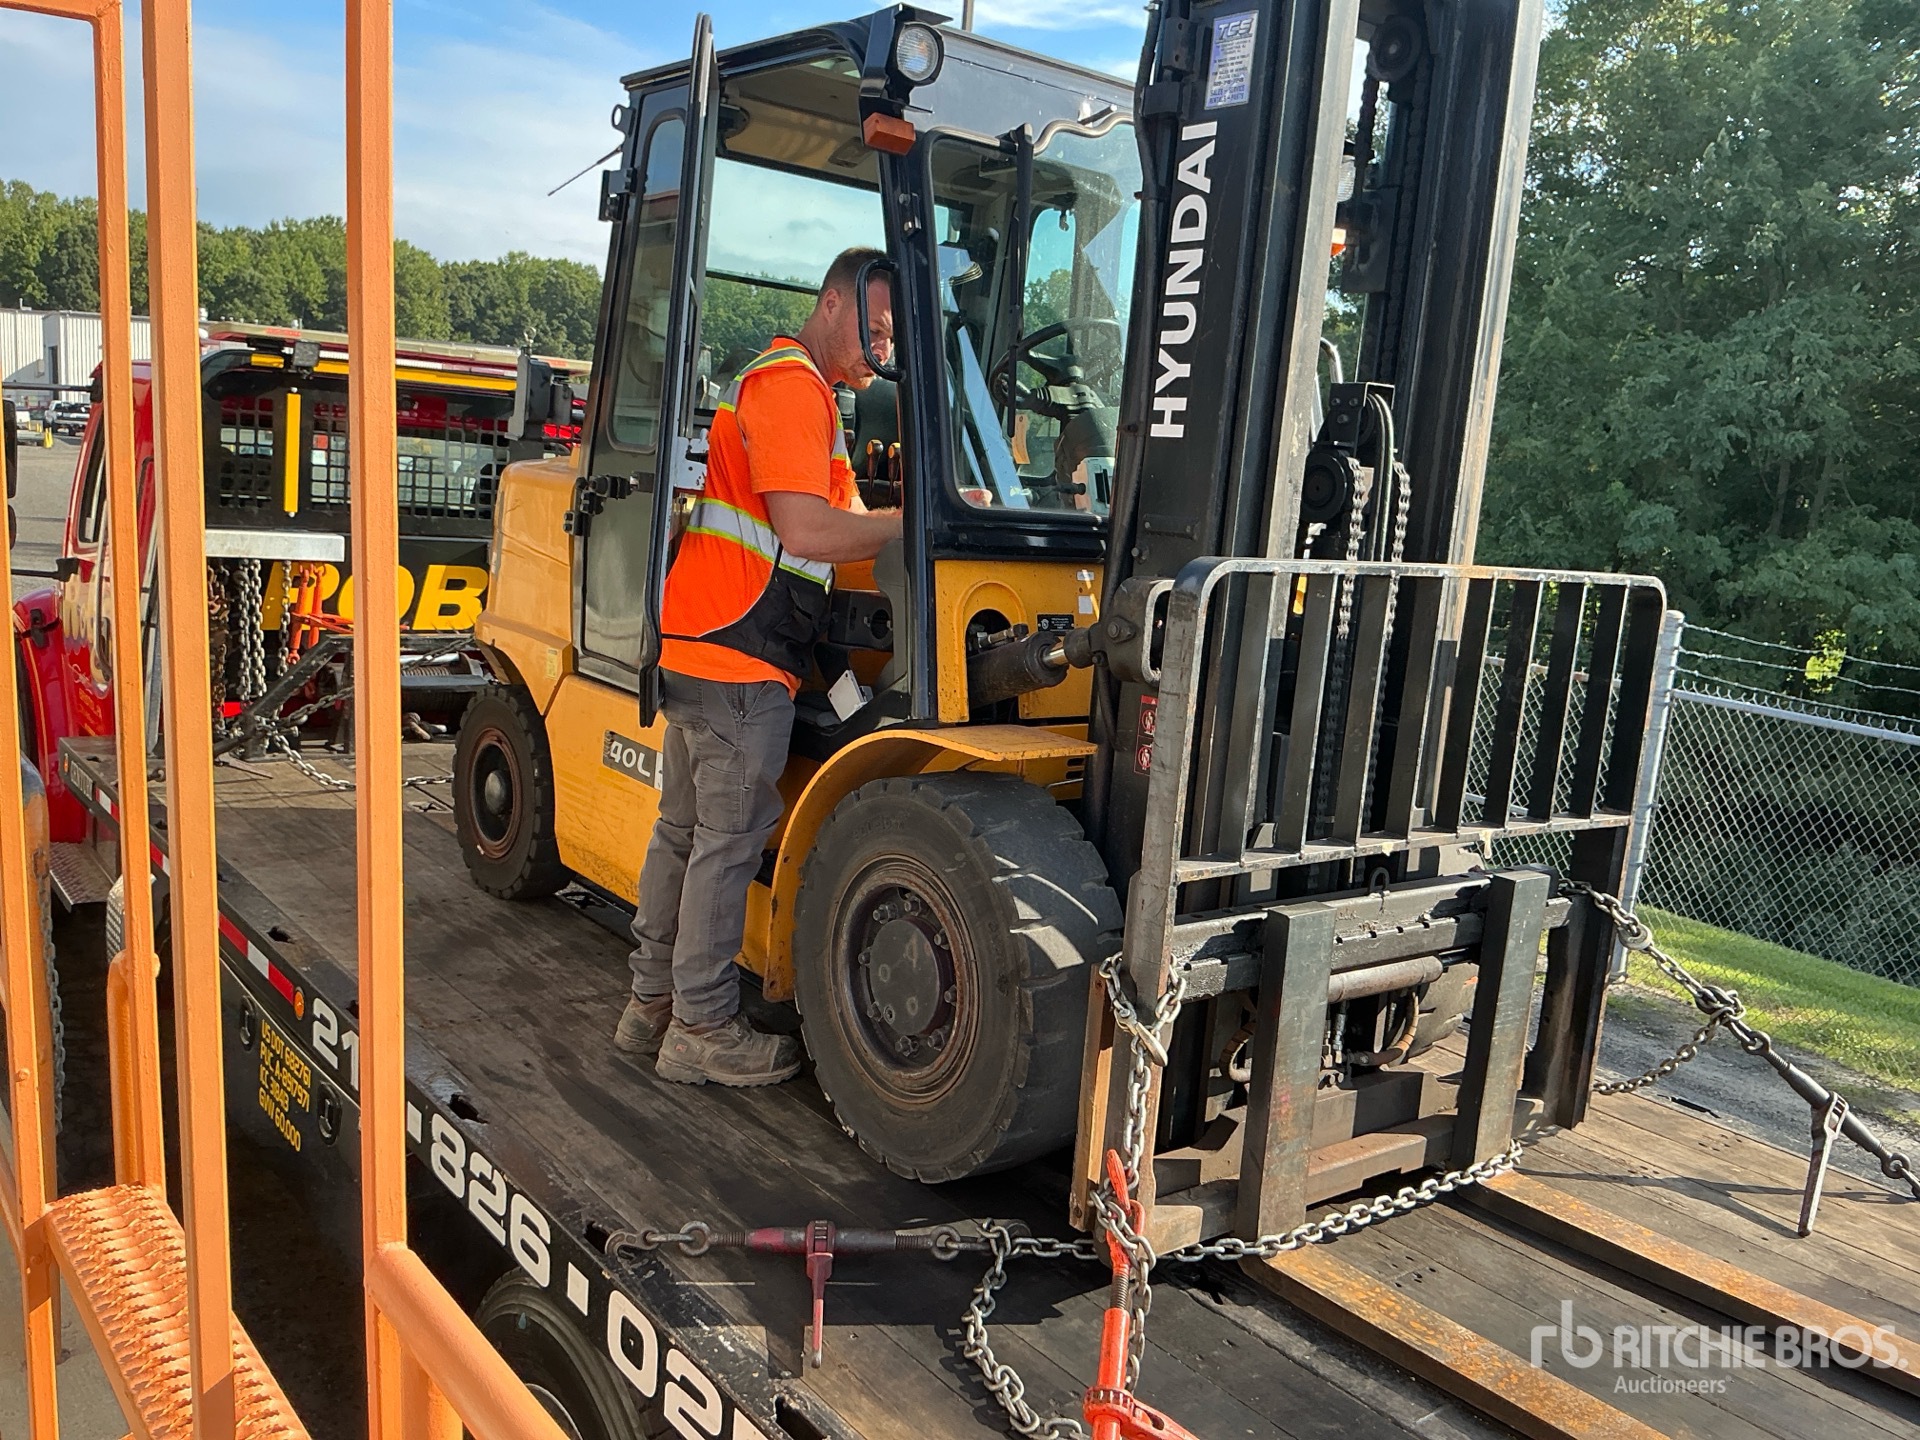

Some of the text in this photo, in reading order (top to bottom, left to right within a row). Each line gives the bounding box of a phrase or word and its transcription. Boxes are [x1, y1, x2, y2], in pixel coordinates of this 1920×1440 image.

[1150, 121, 1217, 438] HYUNDAI
[610, 740, 651, 778] 40L
[260, 1041, 274, 1072] PUC
[261, 1019, 270, 1044] US
[271, 1029, 284, 1059] DOT
